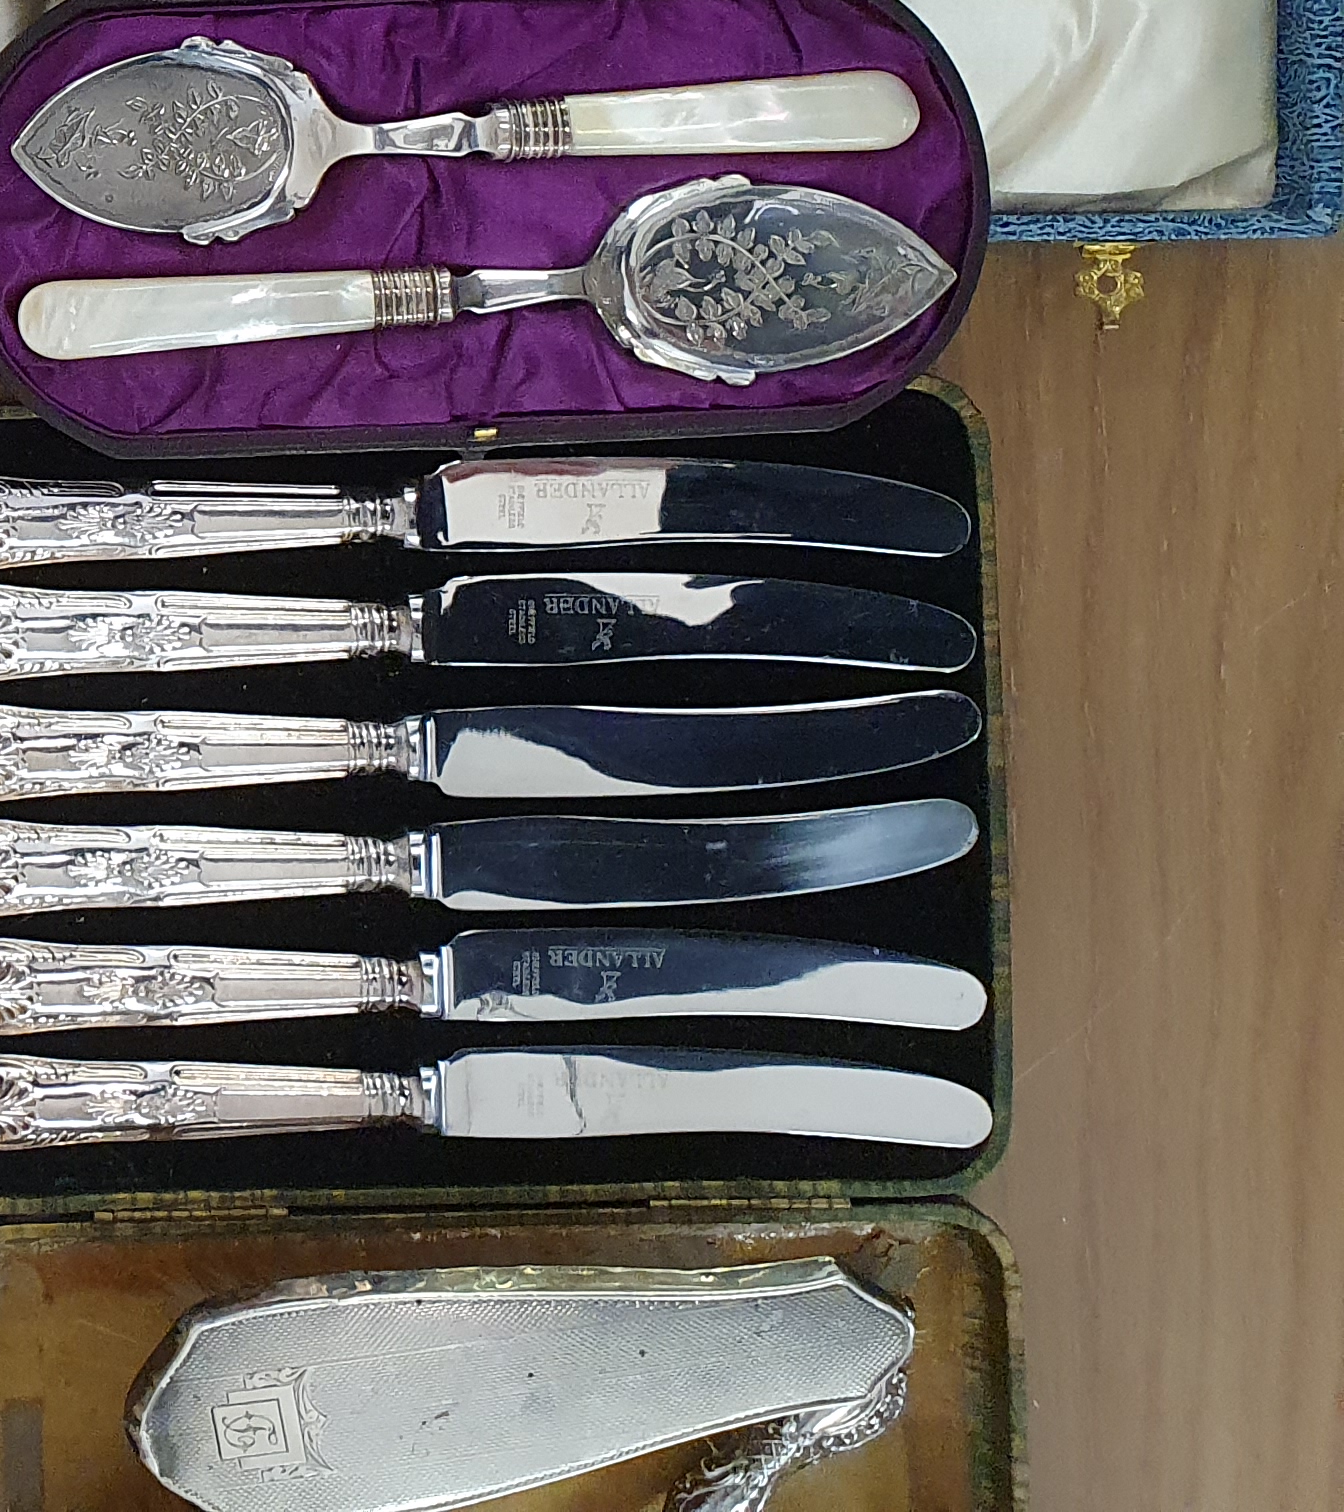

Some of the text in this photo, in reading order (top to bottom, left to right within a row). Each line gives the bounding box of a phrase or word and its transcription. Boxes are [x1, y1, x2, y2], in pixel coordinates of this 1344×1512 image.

[534, 481, 650, 500] ALLANDER
[544, 597, 659, 616] ALLANDER
[548, 950, 665, 969] ALLANDER
